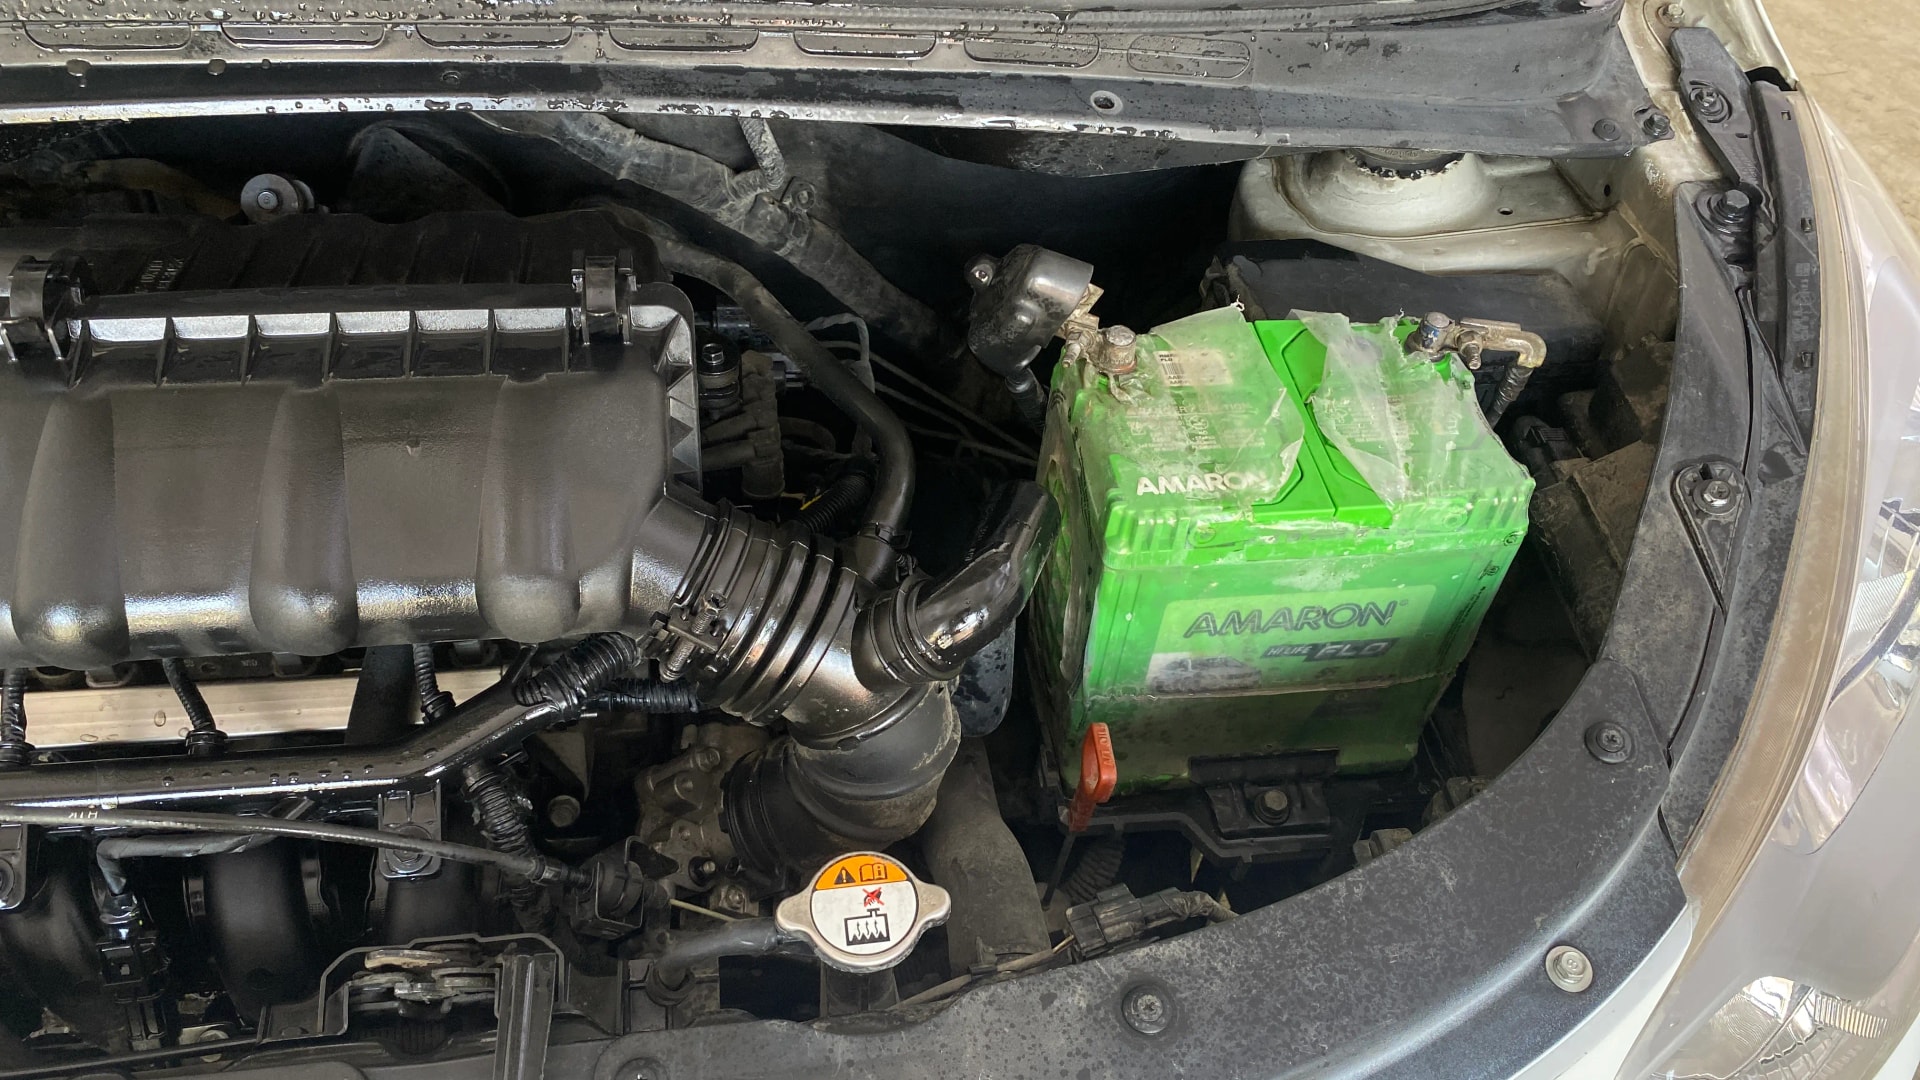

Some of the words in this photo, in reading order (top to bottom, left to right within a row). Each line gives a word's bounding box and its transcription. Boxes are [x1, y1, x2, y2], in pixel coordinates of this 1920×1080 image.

[1136, 472, 1271, 496] AMARON
[1183, 600, 1398, 638] AMARON
[1314, 642, 1389, 659] FLO
